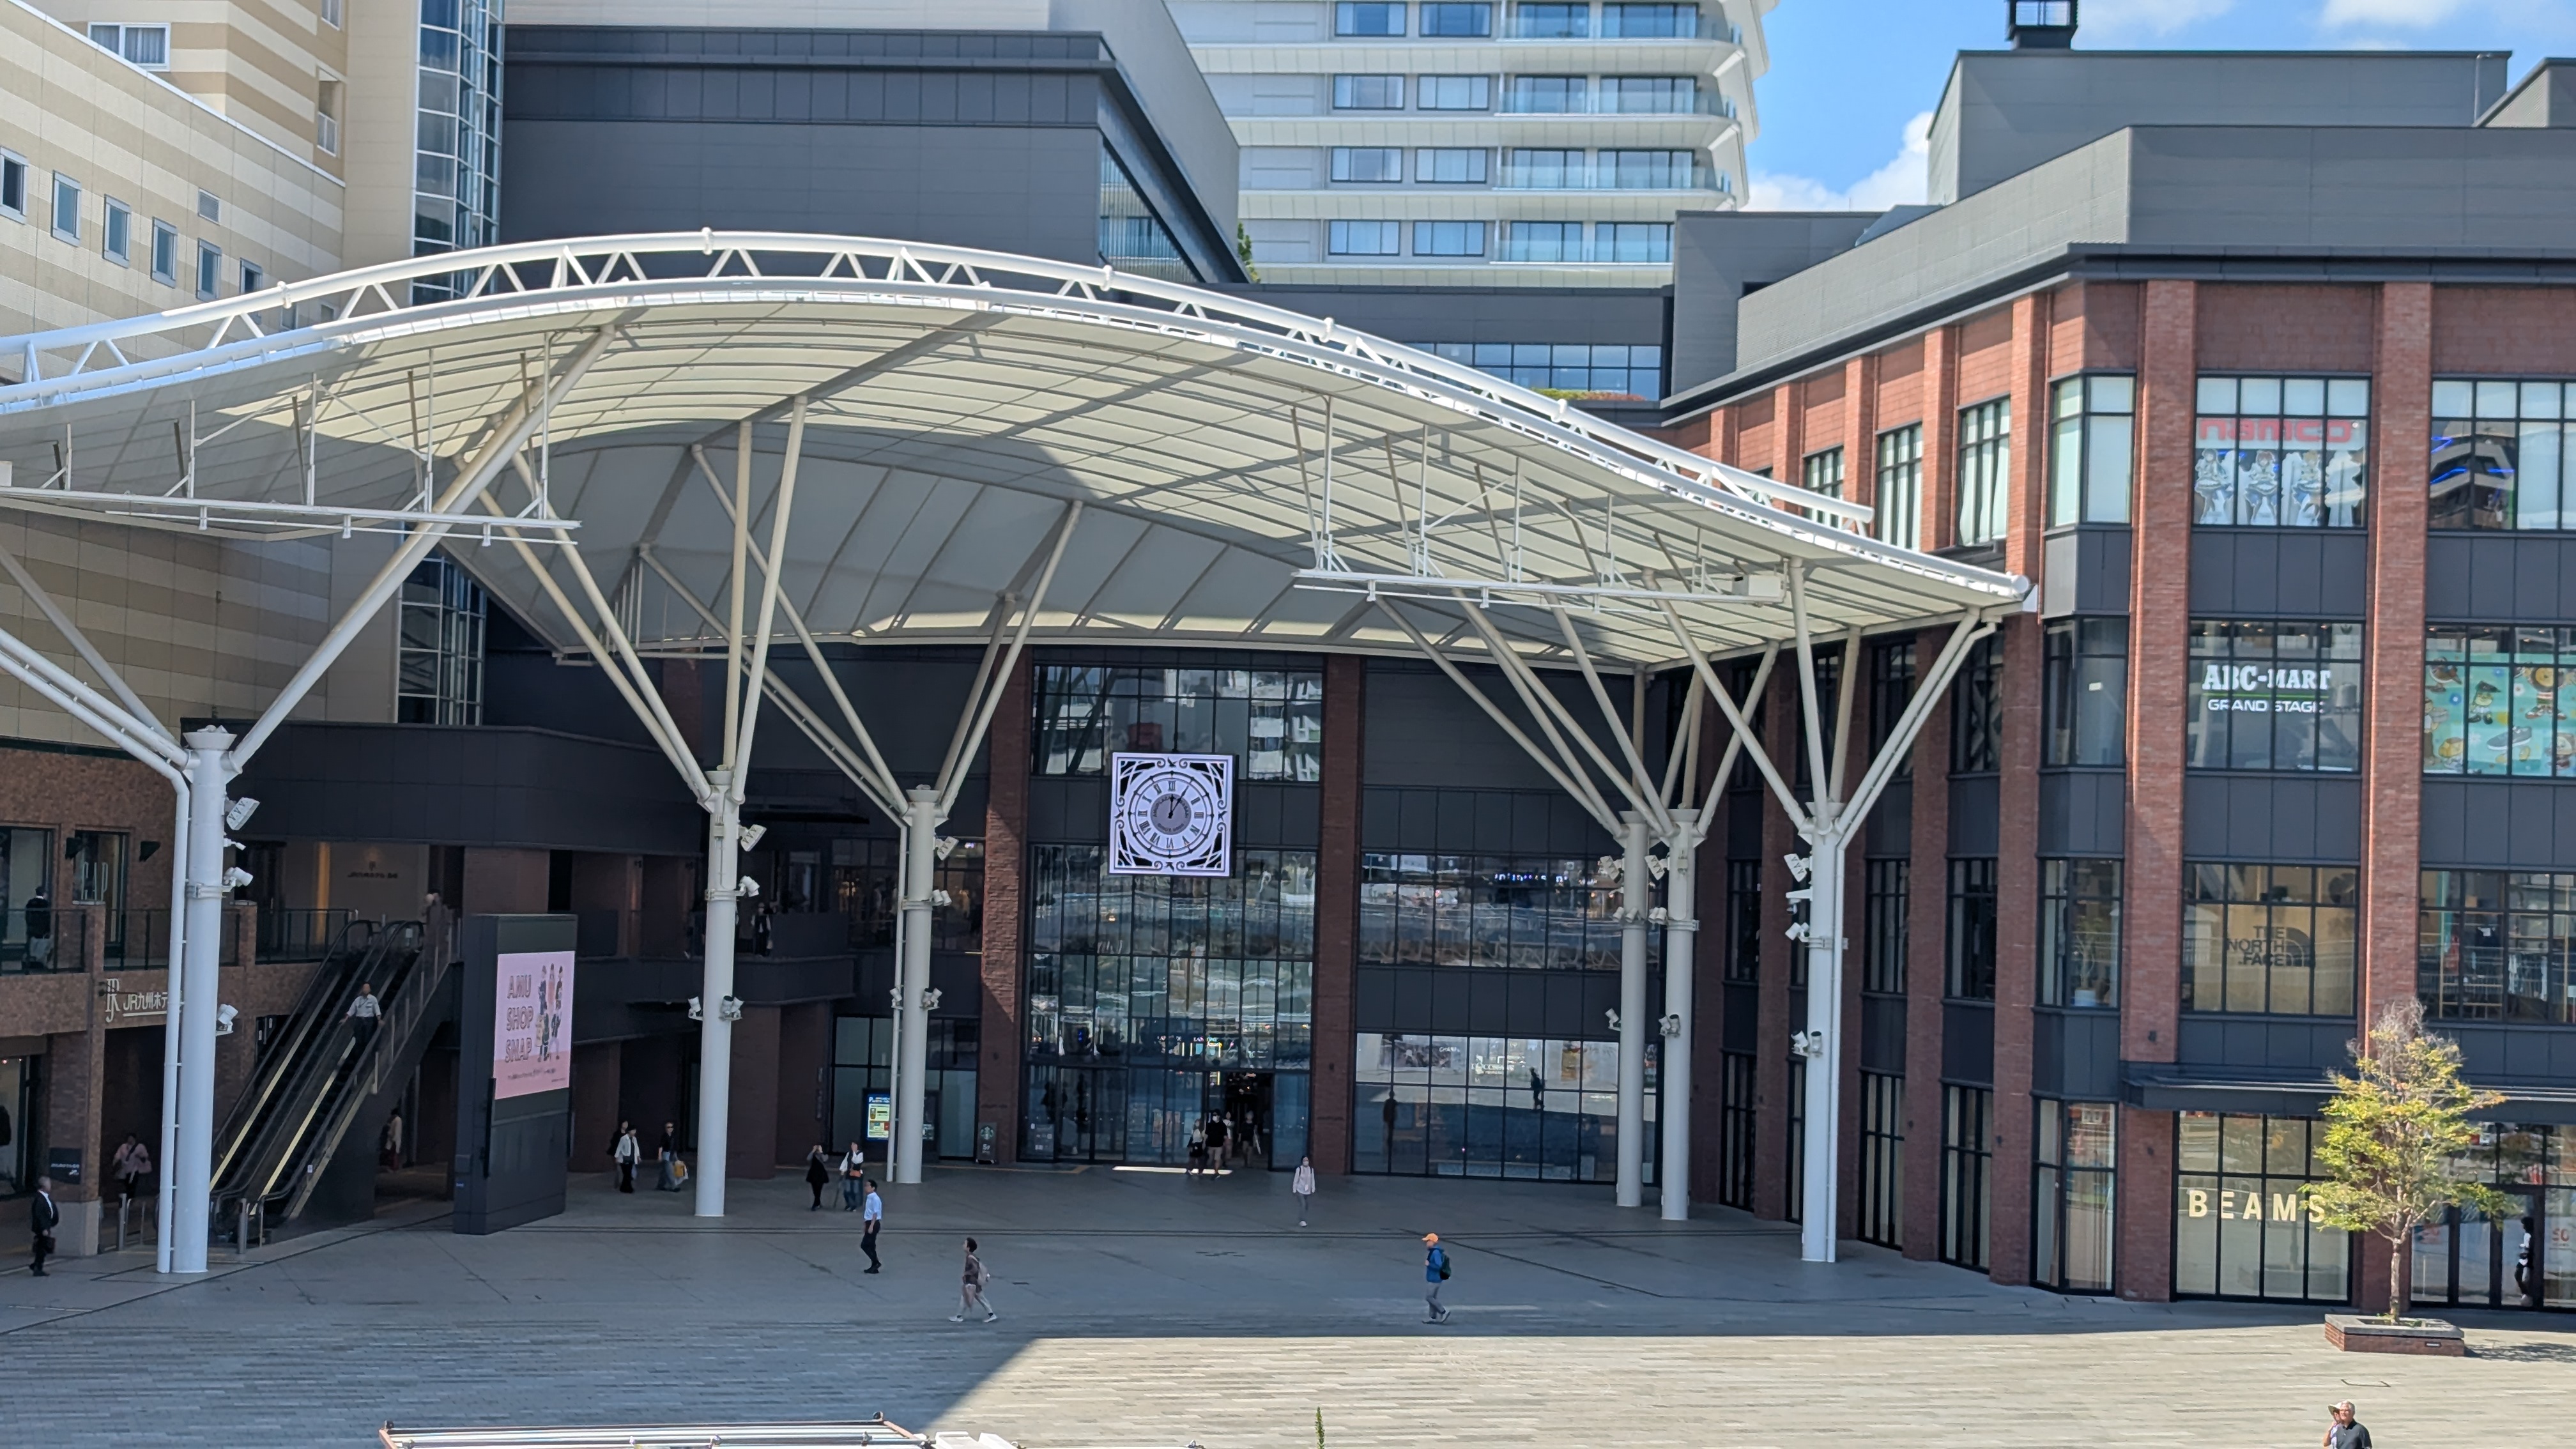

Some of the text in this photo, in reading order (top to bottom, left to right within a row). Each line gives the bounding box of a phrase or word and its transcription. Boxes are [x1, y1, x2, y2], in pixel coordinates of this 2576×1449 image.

[2198, 419, 2352, 443] namco
[2202, 664, 2331, 691] ABC-MART
[2207, 699, 2268, 712] GRAND
[507, 974, 532, 999] AMU
[123, 991, 183, 1012] JR九州ホテ
[506, 1006, 534, 1032] SHOP
[505, 1037, 533, 1063] SNAP
[2189, 1190, 2325, 1223] BEAMS
